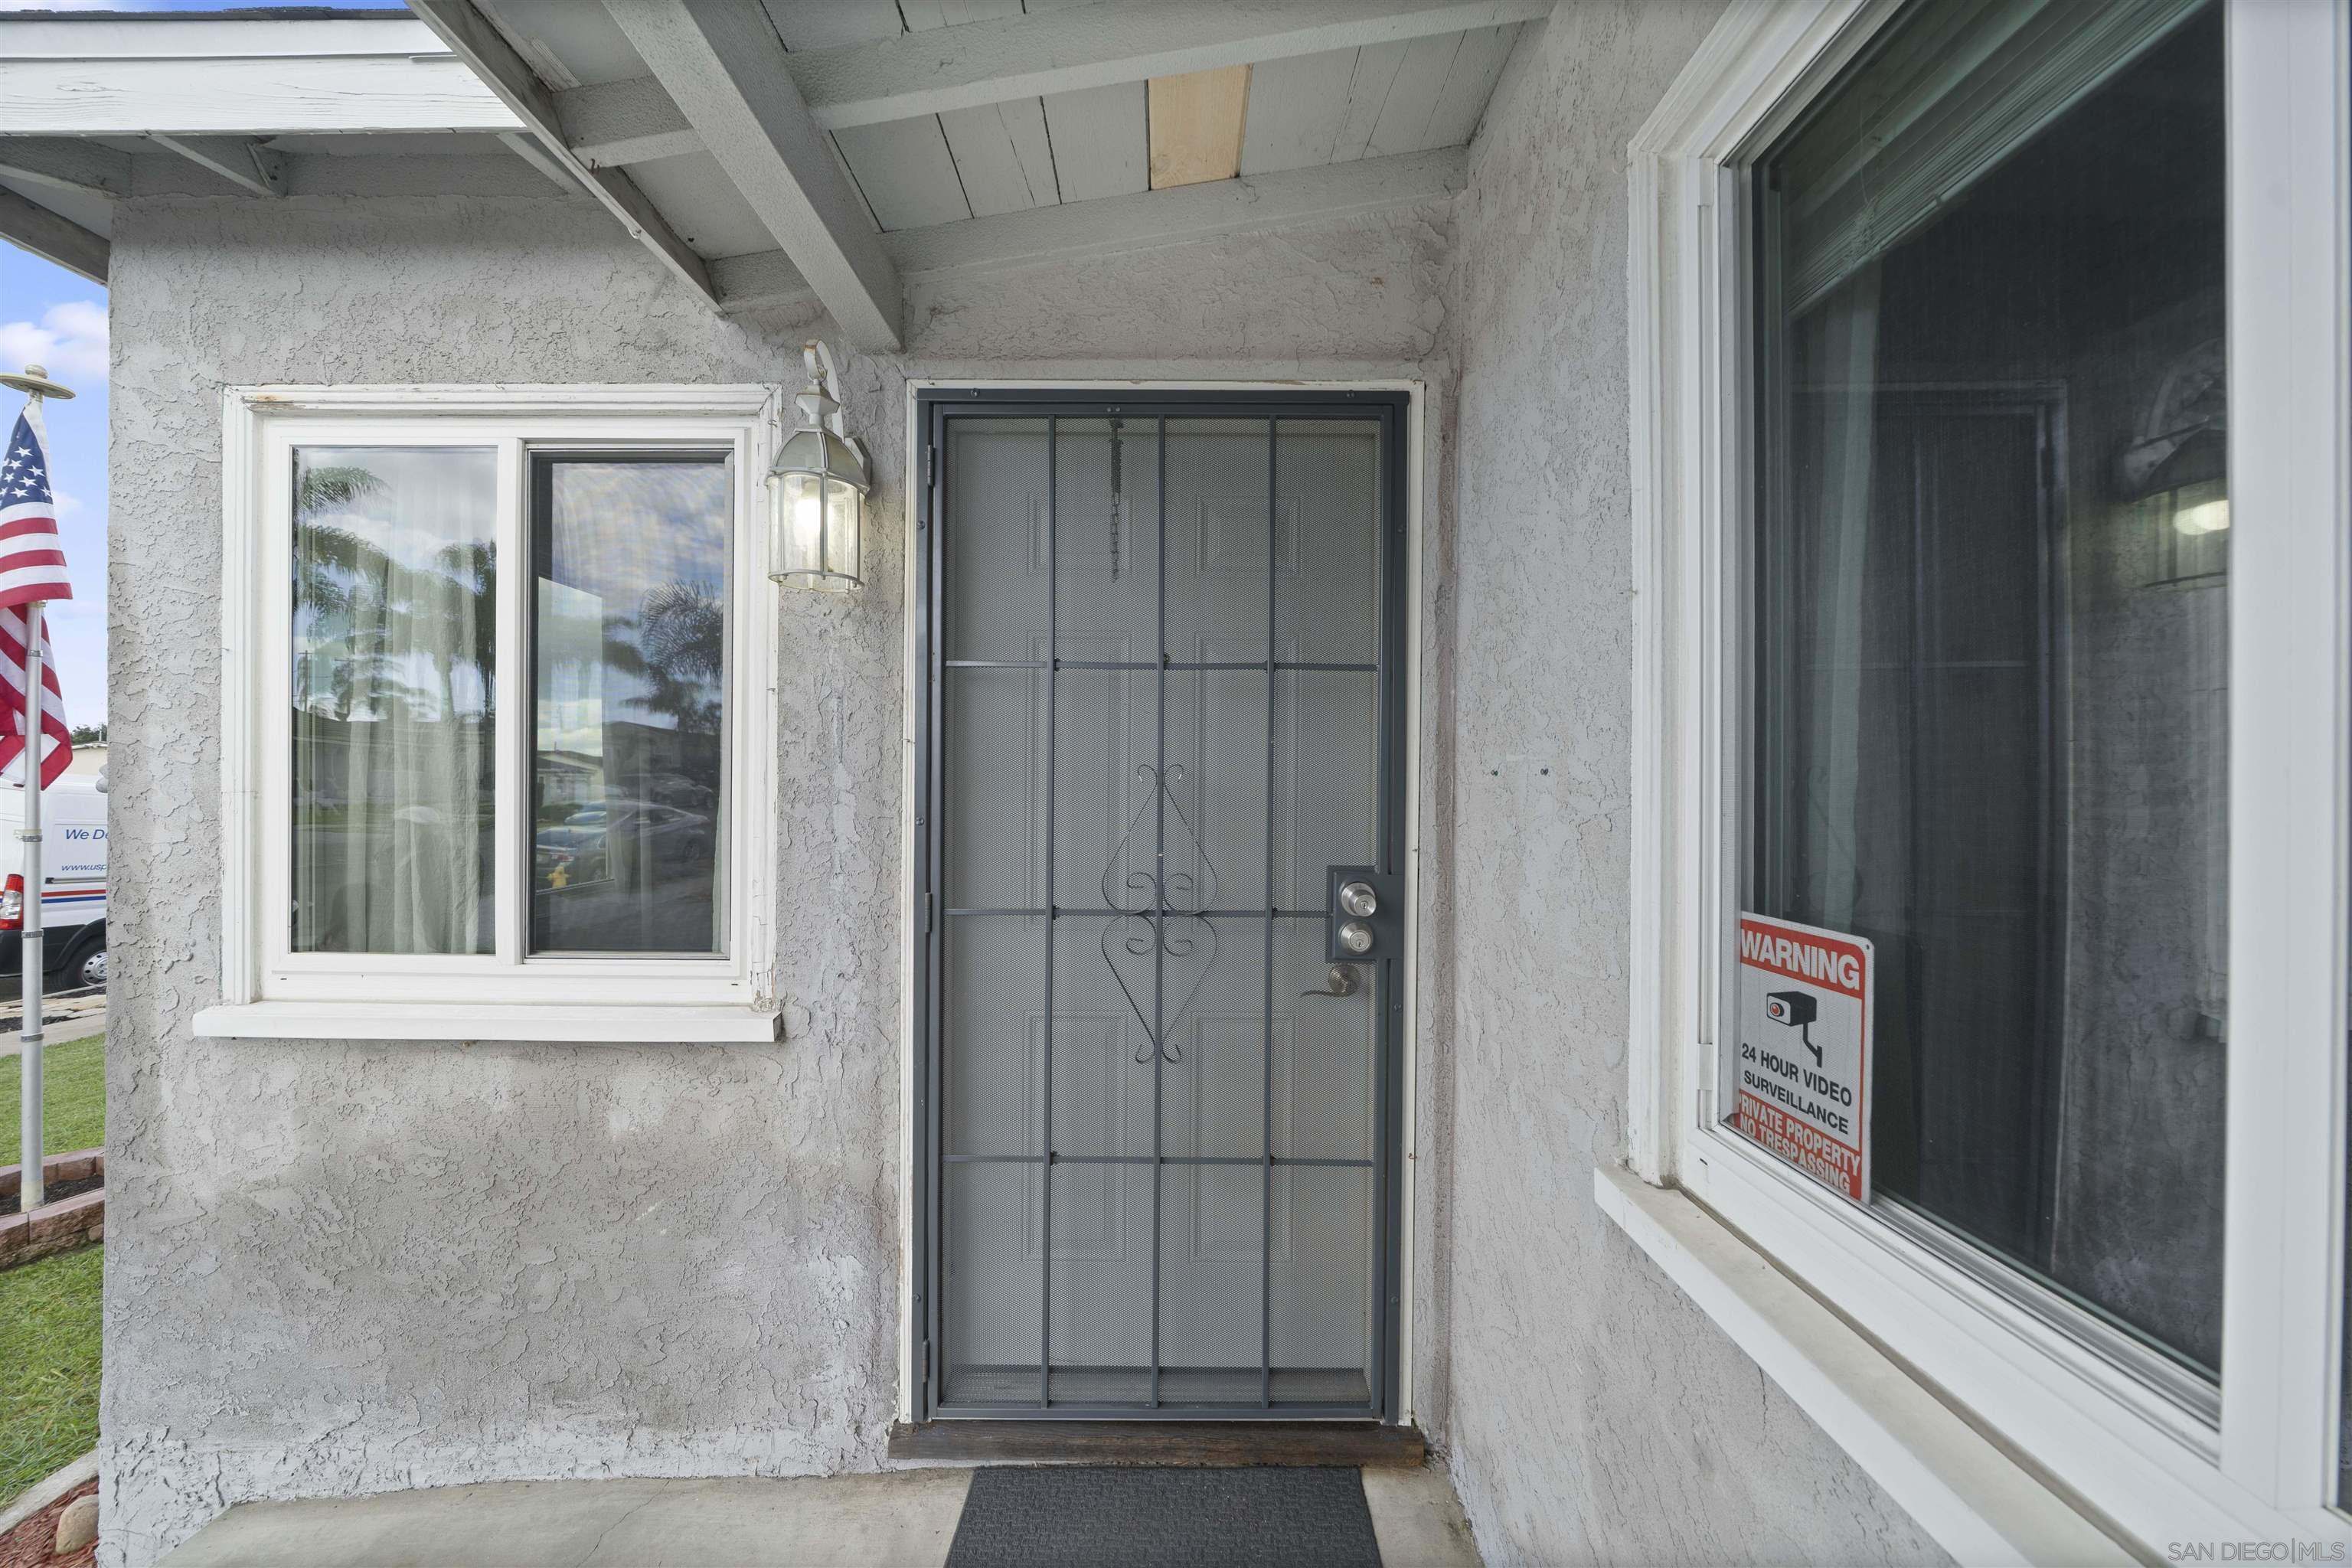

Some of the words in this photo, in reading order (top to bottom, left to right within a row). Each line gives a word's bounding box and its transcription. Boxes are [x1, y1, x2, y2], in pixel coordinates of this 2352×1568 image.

[66, 829, 89, 840] We
[1740, 927, 1860, 991] WARNING
[1742, 1042, 1757, 1063] 24
[1760, 1048, 1799, 1084] HOUR
[1802, 1067, 1853, 1107] VIDEO
[1743, 1070, 1849, 1135] SURVEILLANCE
[1739, 1093, 1784, 1134] RIVATE
[1785, 1117, 1860, 1177] PROPERTY
[1740, 1112, 1756, 1138] NO
[1758, 1124, 1851, 1194] TRESPASSING
